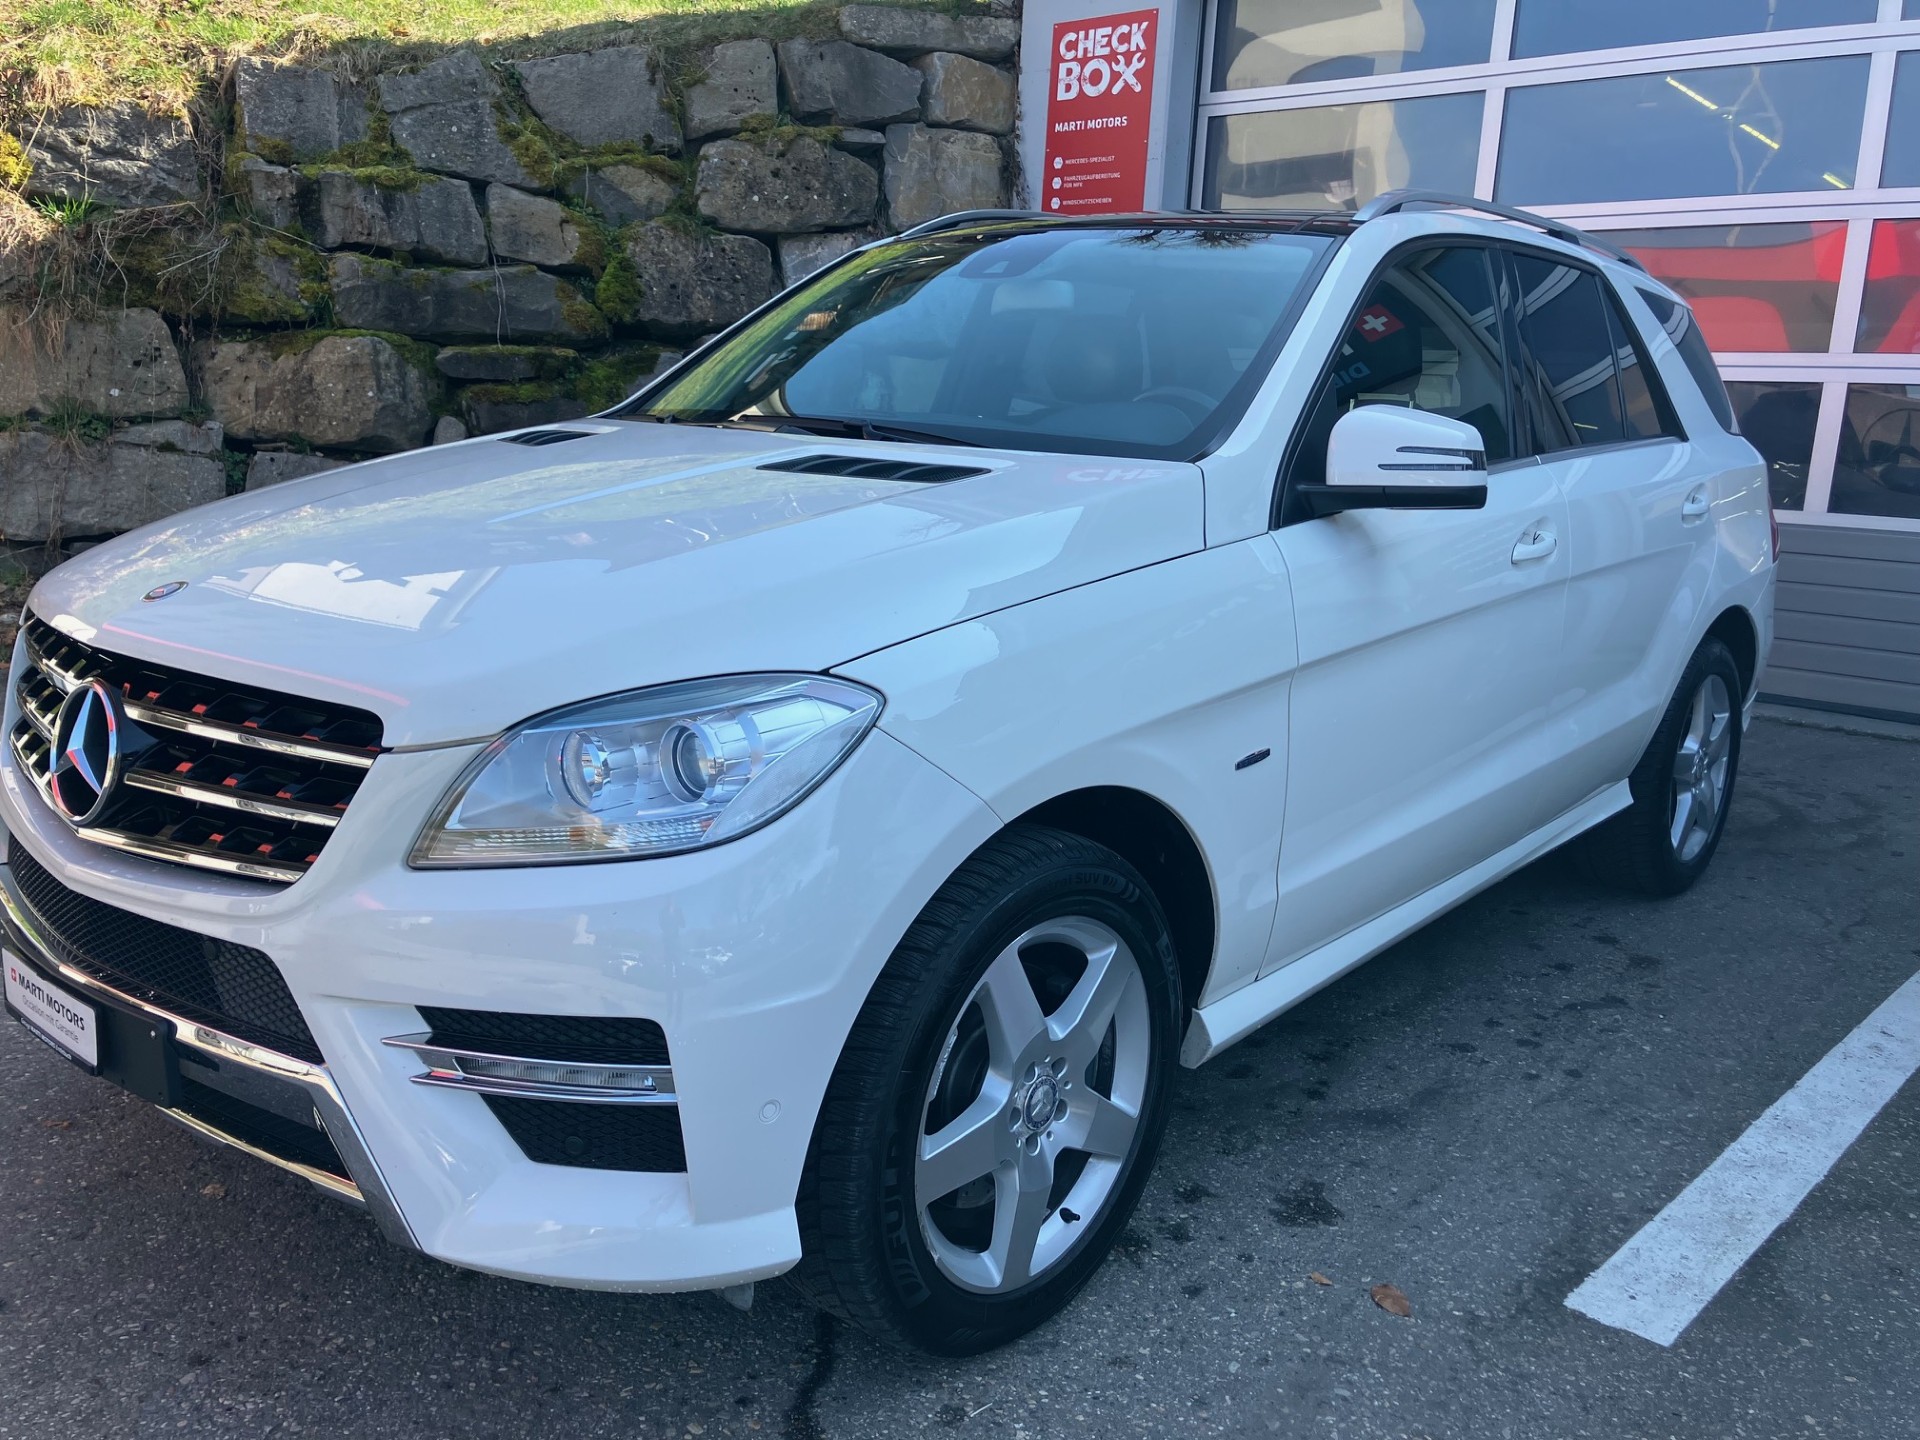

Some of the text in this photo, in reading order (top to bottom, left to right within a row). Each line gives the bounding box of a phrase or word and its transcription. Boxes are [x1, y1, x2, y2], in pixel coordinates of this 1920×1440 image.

[1059, 21, 1149, 60] CHECK
[1055, 116, 1128, 133] MARTI MOTORS
[18, 973, 85, 1031] MARTI MOTORS
